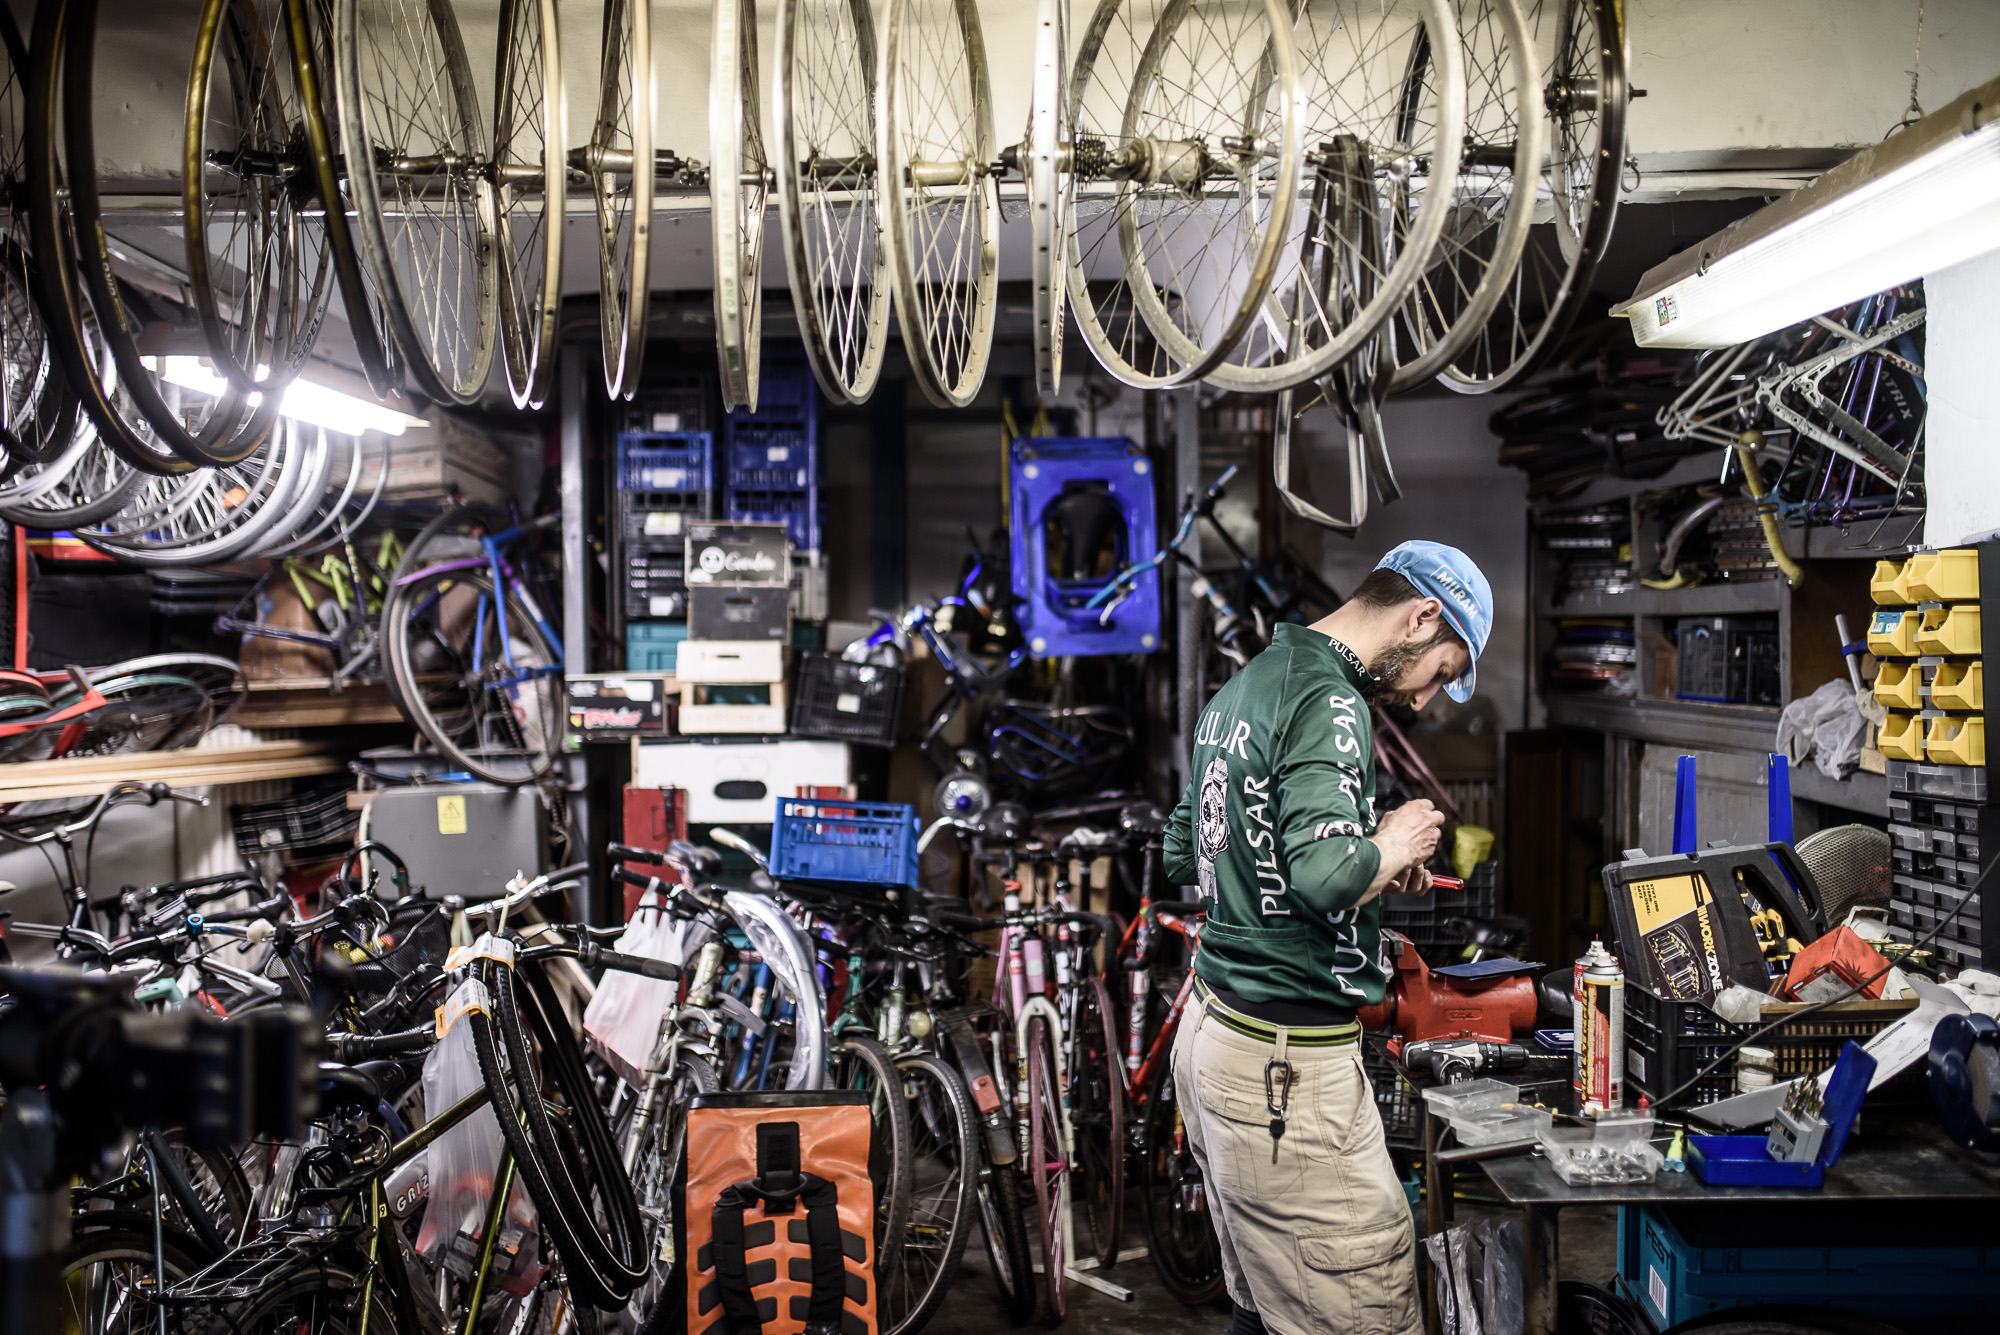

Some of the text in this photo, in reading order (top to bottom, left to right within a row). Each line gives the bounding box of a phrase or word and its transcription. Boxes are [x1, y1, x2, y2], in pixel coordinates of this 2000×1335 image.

[292, 316, 321, 369] CSEPEL
[1880, 369, 1913, 420] ATRIX
[1436, 570, 1478, 620] MILRAM
[1328, 638, 1366, 677] PULSAR
[1243, 775, 1291, 917] PULSAR
[396, 1174, 430, 1213] GRIZ
[1646, 1220, 1670, 1271] FEST
